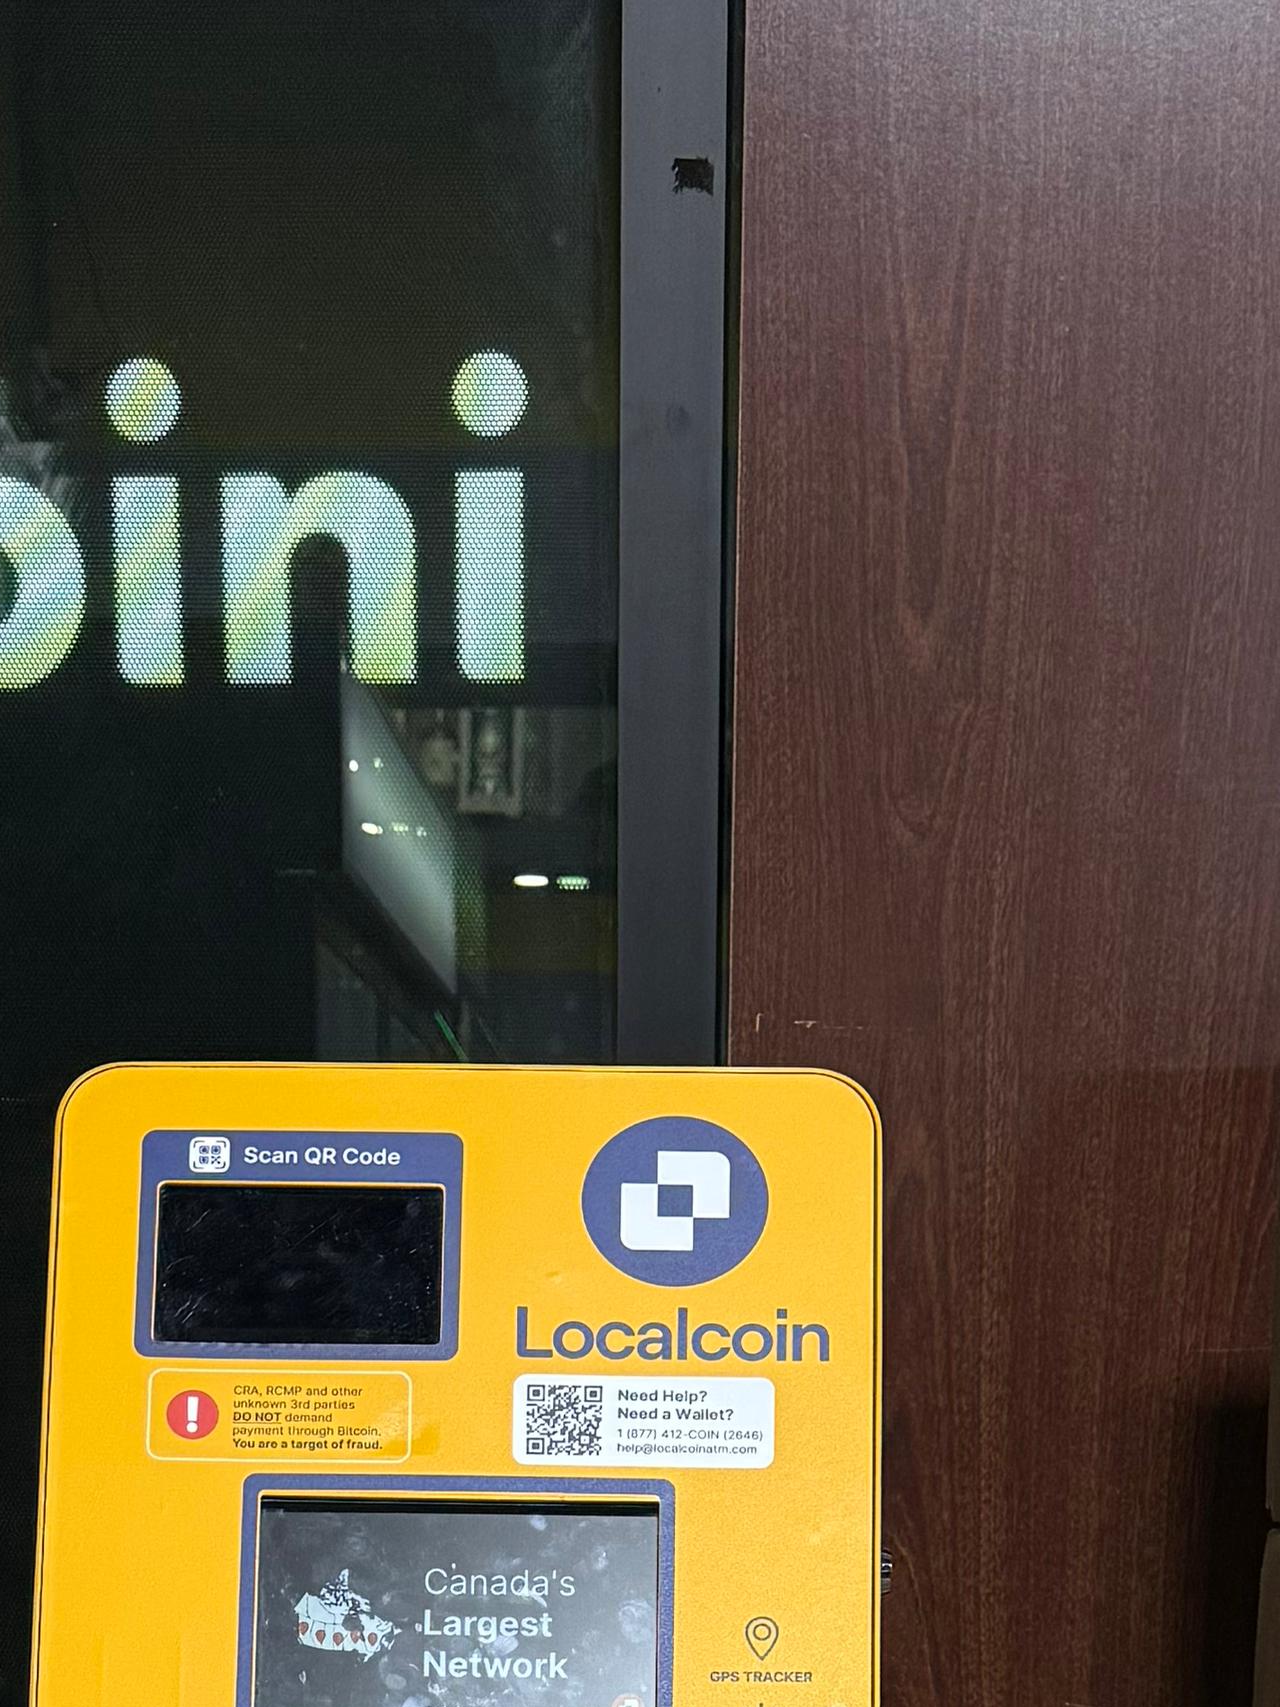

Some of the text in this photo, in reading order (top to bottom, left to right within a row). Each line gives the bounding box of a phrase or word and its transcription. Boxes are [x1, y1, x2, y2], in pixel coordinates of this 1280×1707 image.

[243, 1146, 401, 1165] Scan QR Code
[516, 1306, 830, 1361] Localcoin
[617, 1390, 708, 1403] Need Help?
[233, 1400, 355, 1411] unknown 3rd parties
[255, 1412, 332, 1422] NOT demand
[617, 1408, 734, 1421] Need a Wallet?
[233, 1427, 284, 1437] payment
[288, 1426, 334, 1438] through
[626, 1428, 657, 1440] (877)
[661, 1429, 719, 1440] 412-COIN
[723, 1430, 763, 1442] (2646)
[233, 1439, 383, 1451] You are a target of fraud.
[617, 1443, 758, 1455] help@localcoinatm.com
[424, 1568, 575, 1596] Canada's
[423, 1608, 553, 1643] Largest
[423, 1650, 568, 1679] Network
[710, 1671, 812, 1682] GPS TRACKER
